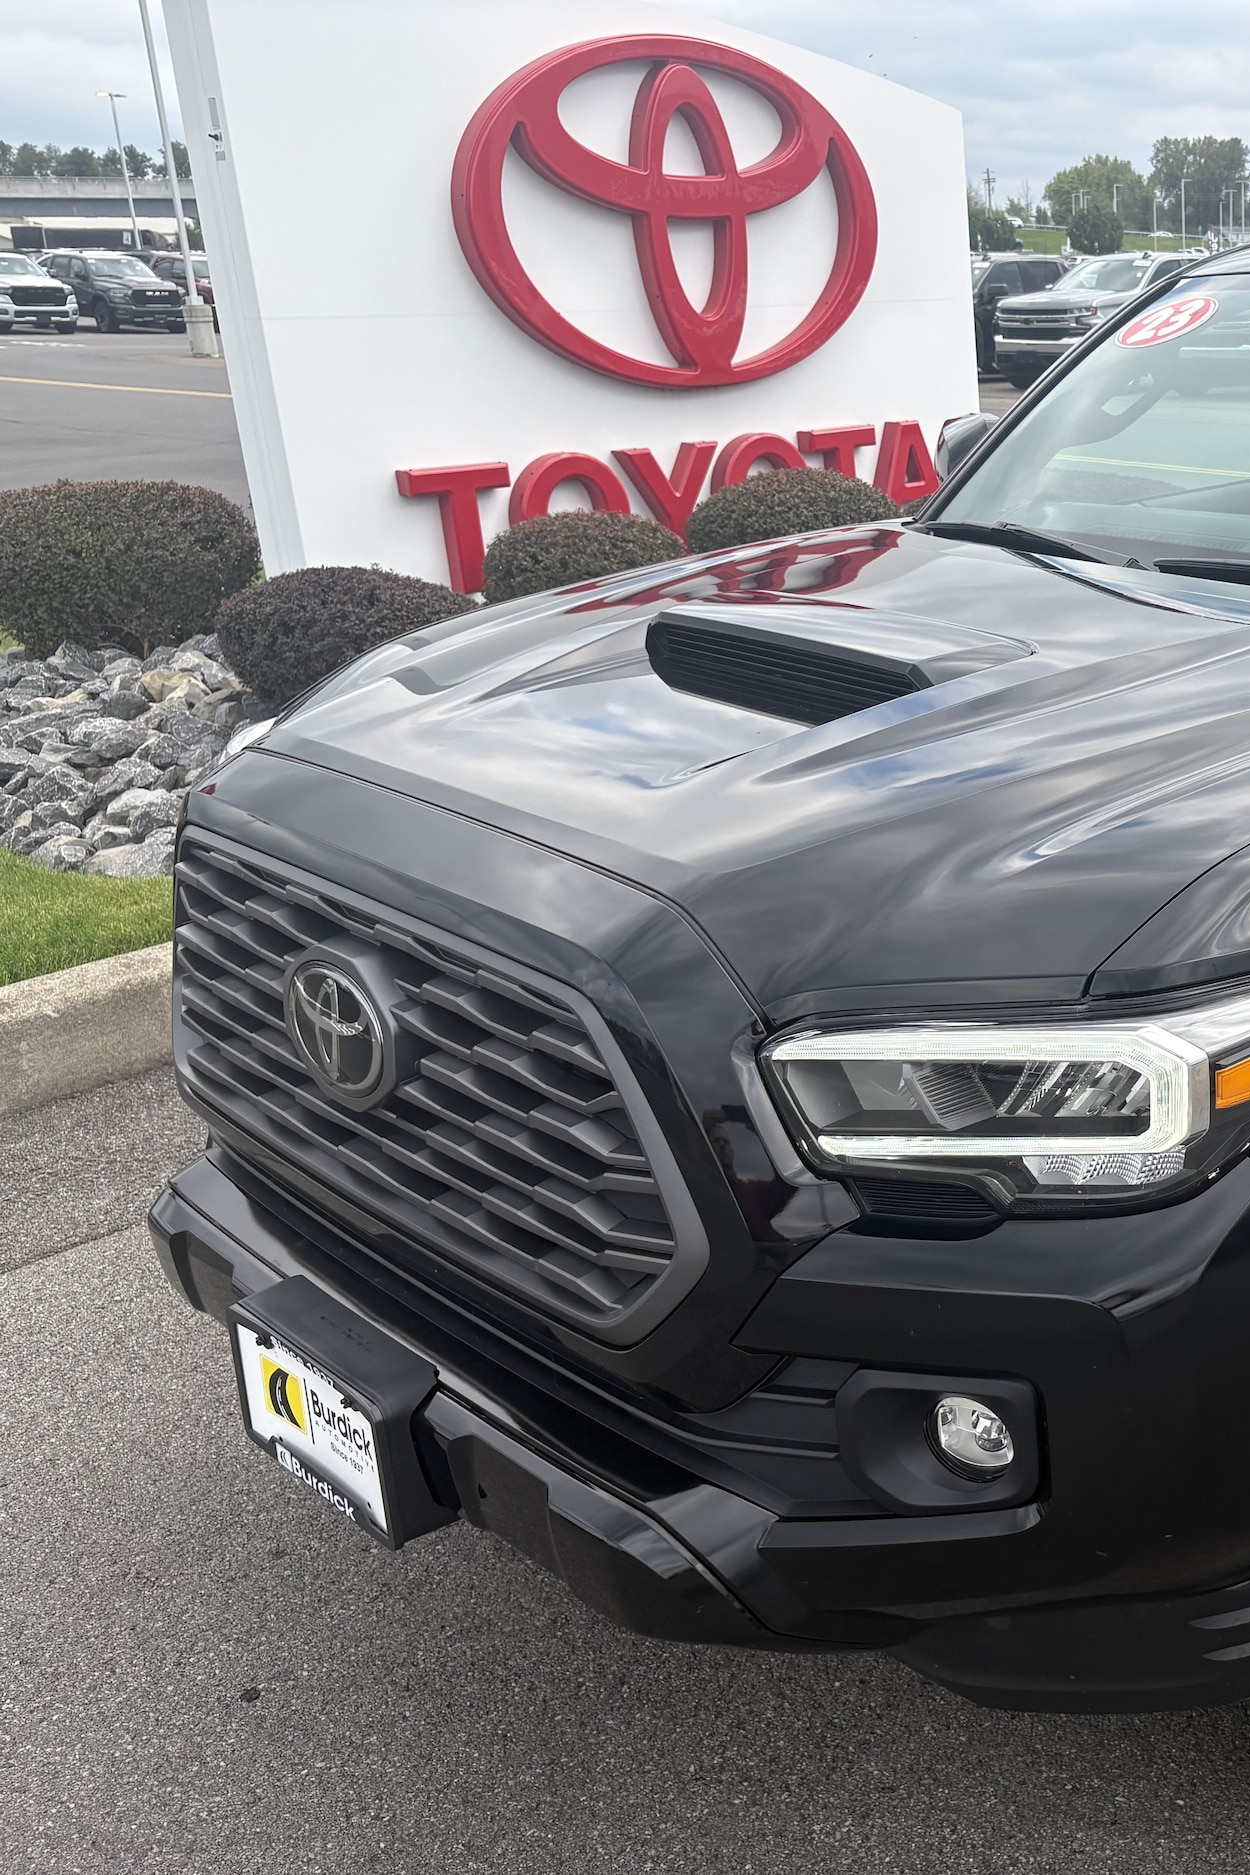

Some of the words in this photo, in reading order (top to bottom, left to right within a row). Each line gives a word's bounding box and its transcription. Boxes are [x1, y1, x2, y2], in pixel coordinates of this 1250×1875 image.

[1125, 298, 1206, 345] 23
[310, 1388, 374, 1462] Burdick
[315, 1419, 375, 1473] AUTOMOTIVE
[330, 1441, 349, 1462] Since
[291, 1455, 356, 1521] Burdick
